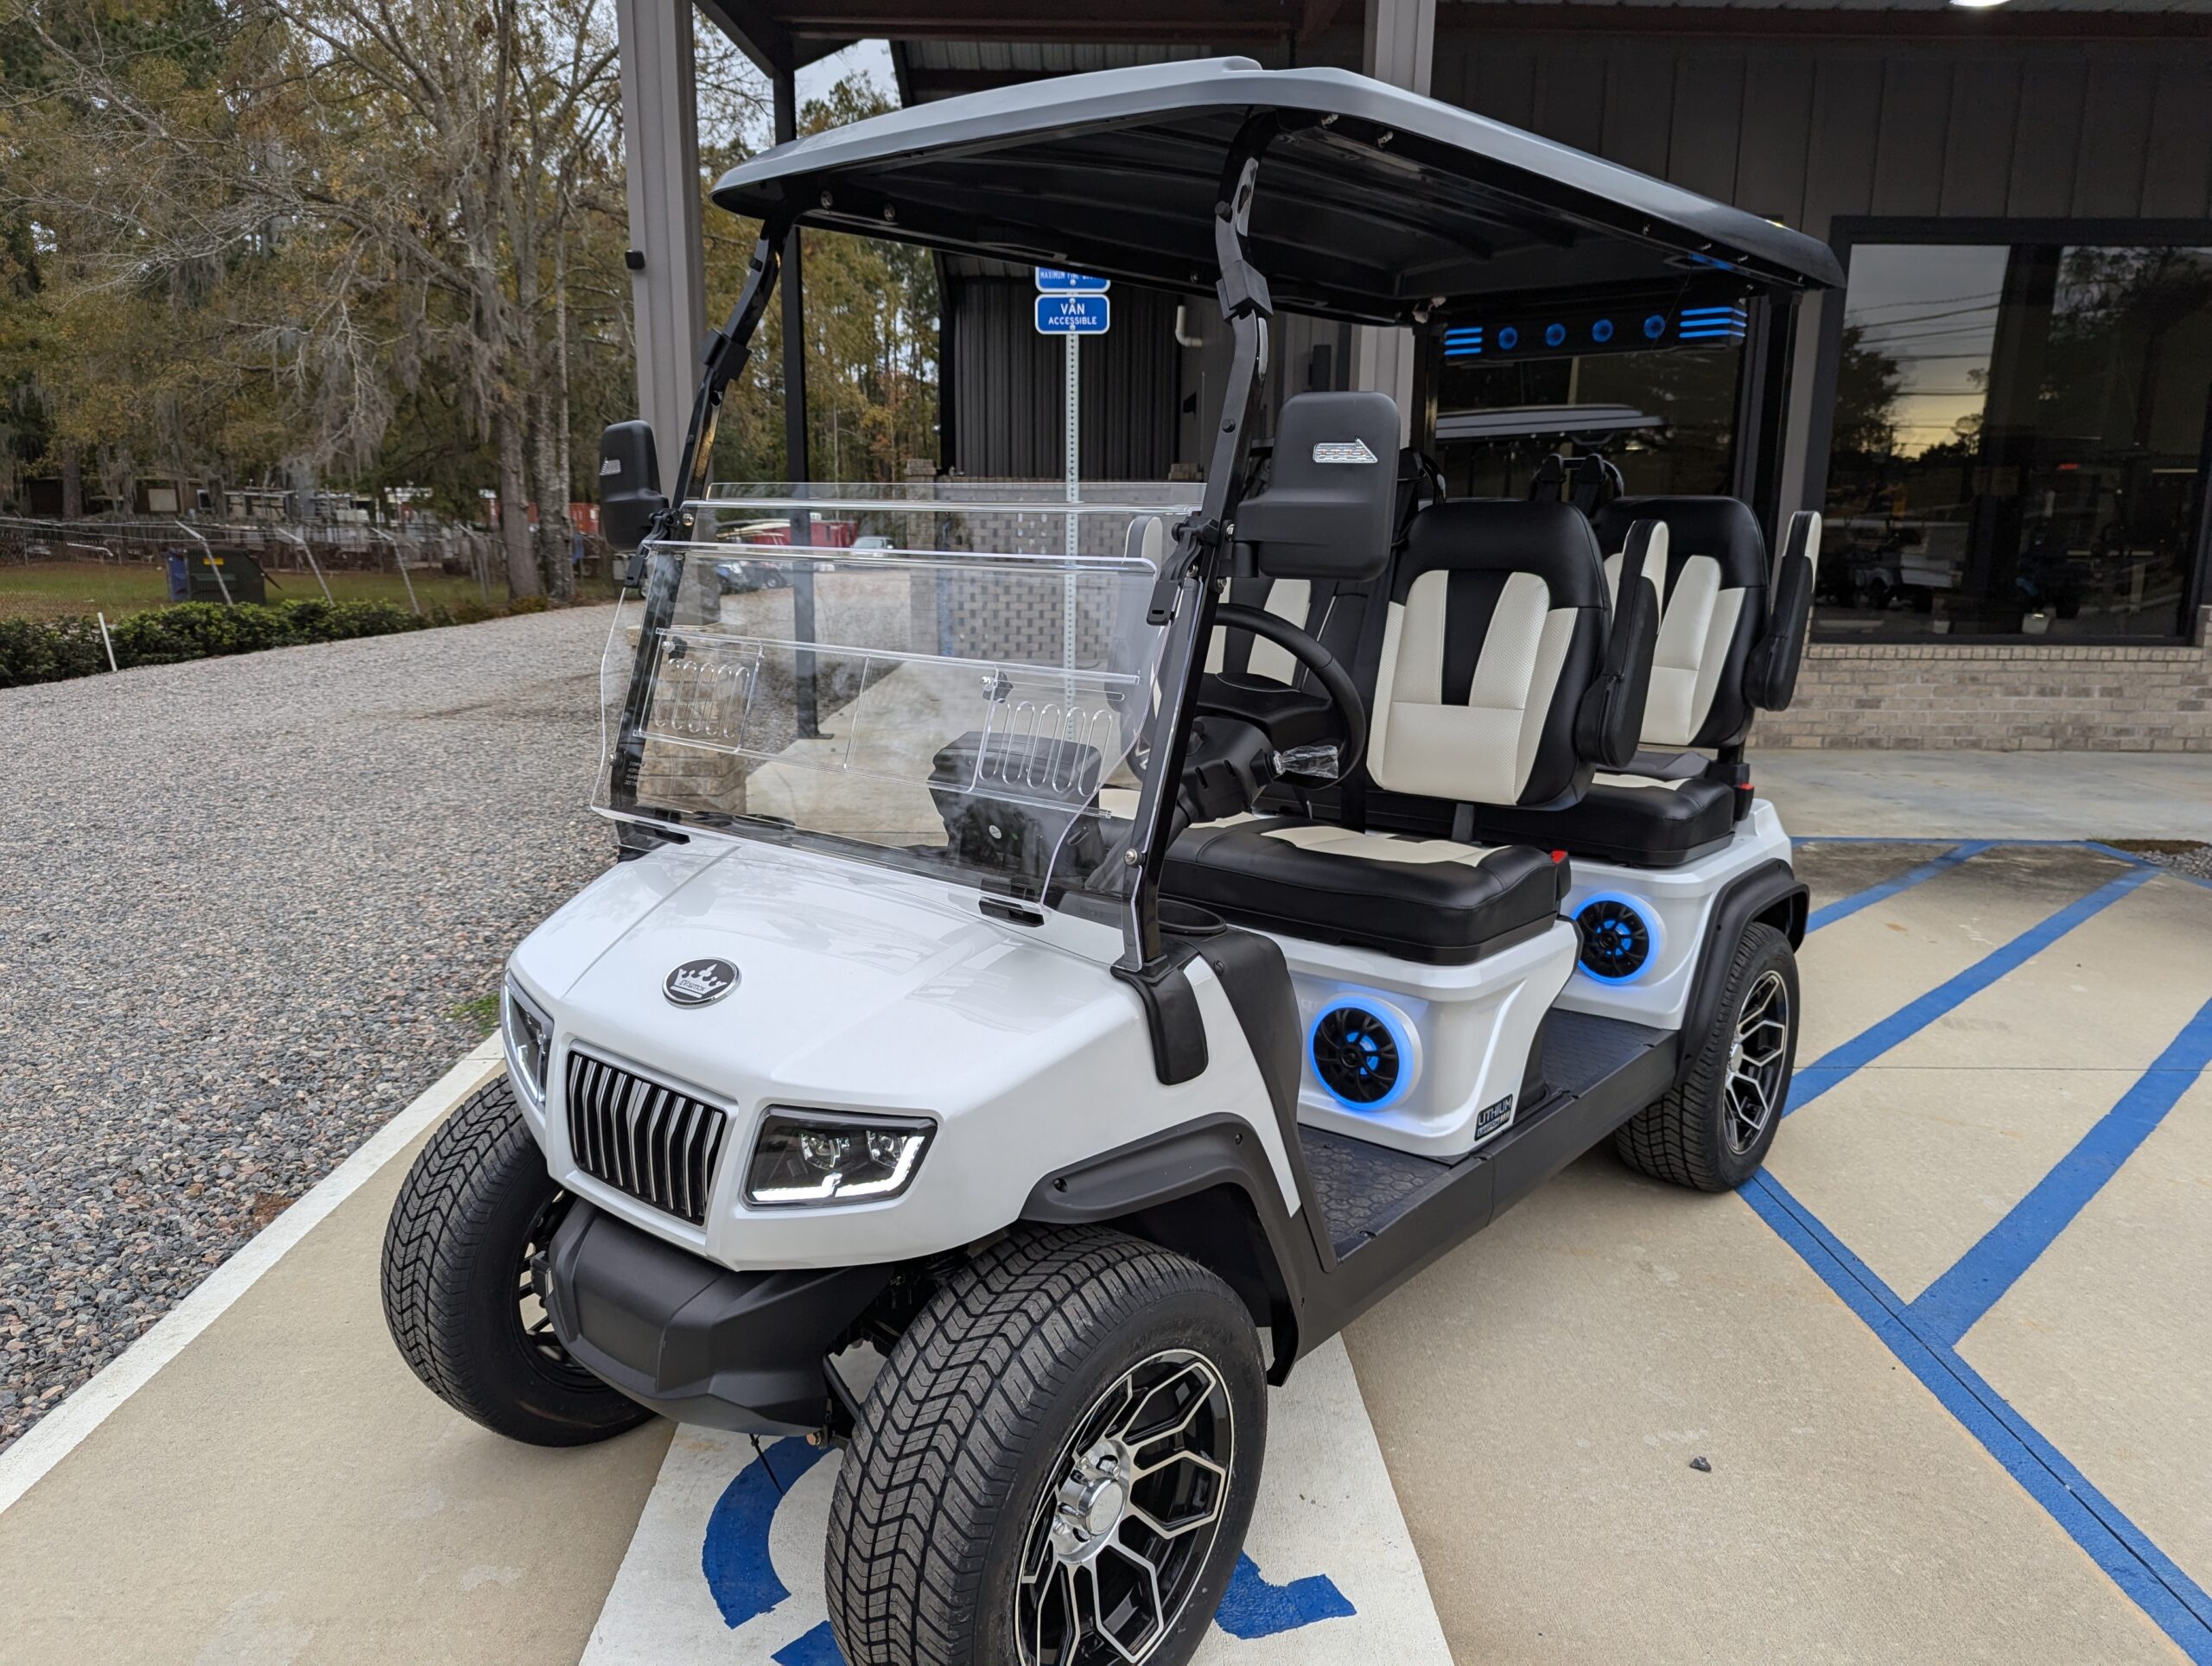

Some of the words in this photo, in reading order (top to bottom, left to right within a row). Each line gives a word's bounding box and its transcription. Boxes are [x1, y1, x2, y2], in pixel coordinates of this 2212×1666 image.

[1060, 303, 1085, 315] VAN
[1048, 316, 1097, 325] ACCESSIBLE
[1478, 1097, 1512, 1126] LITHIUM
